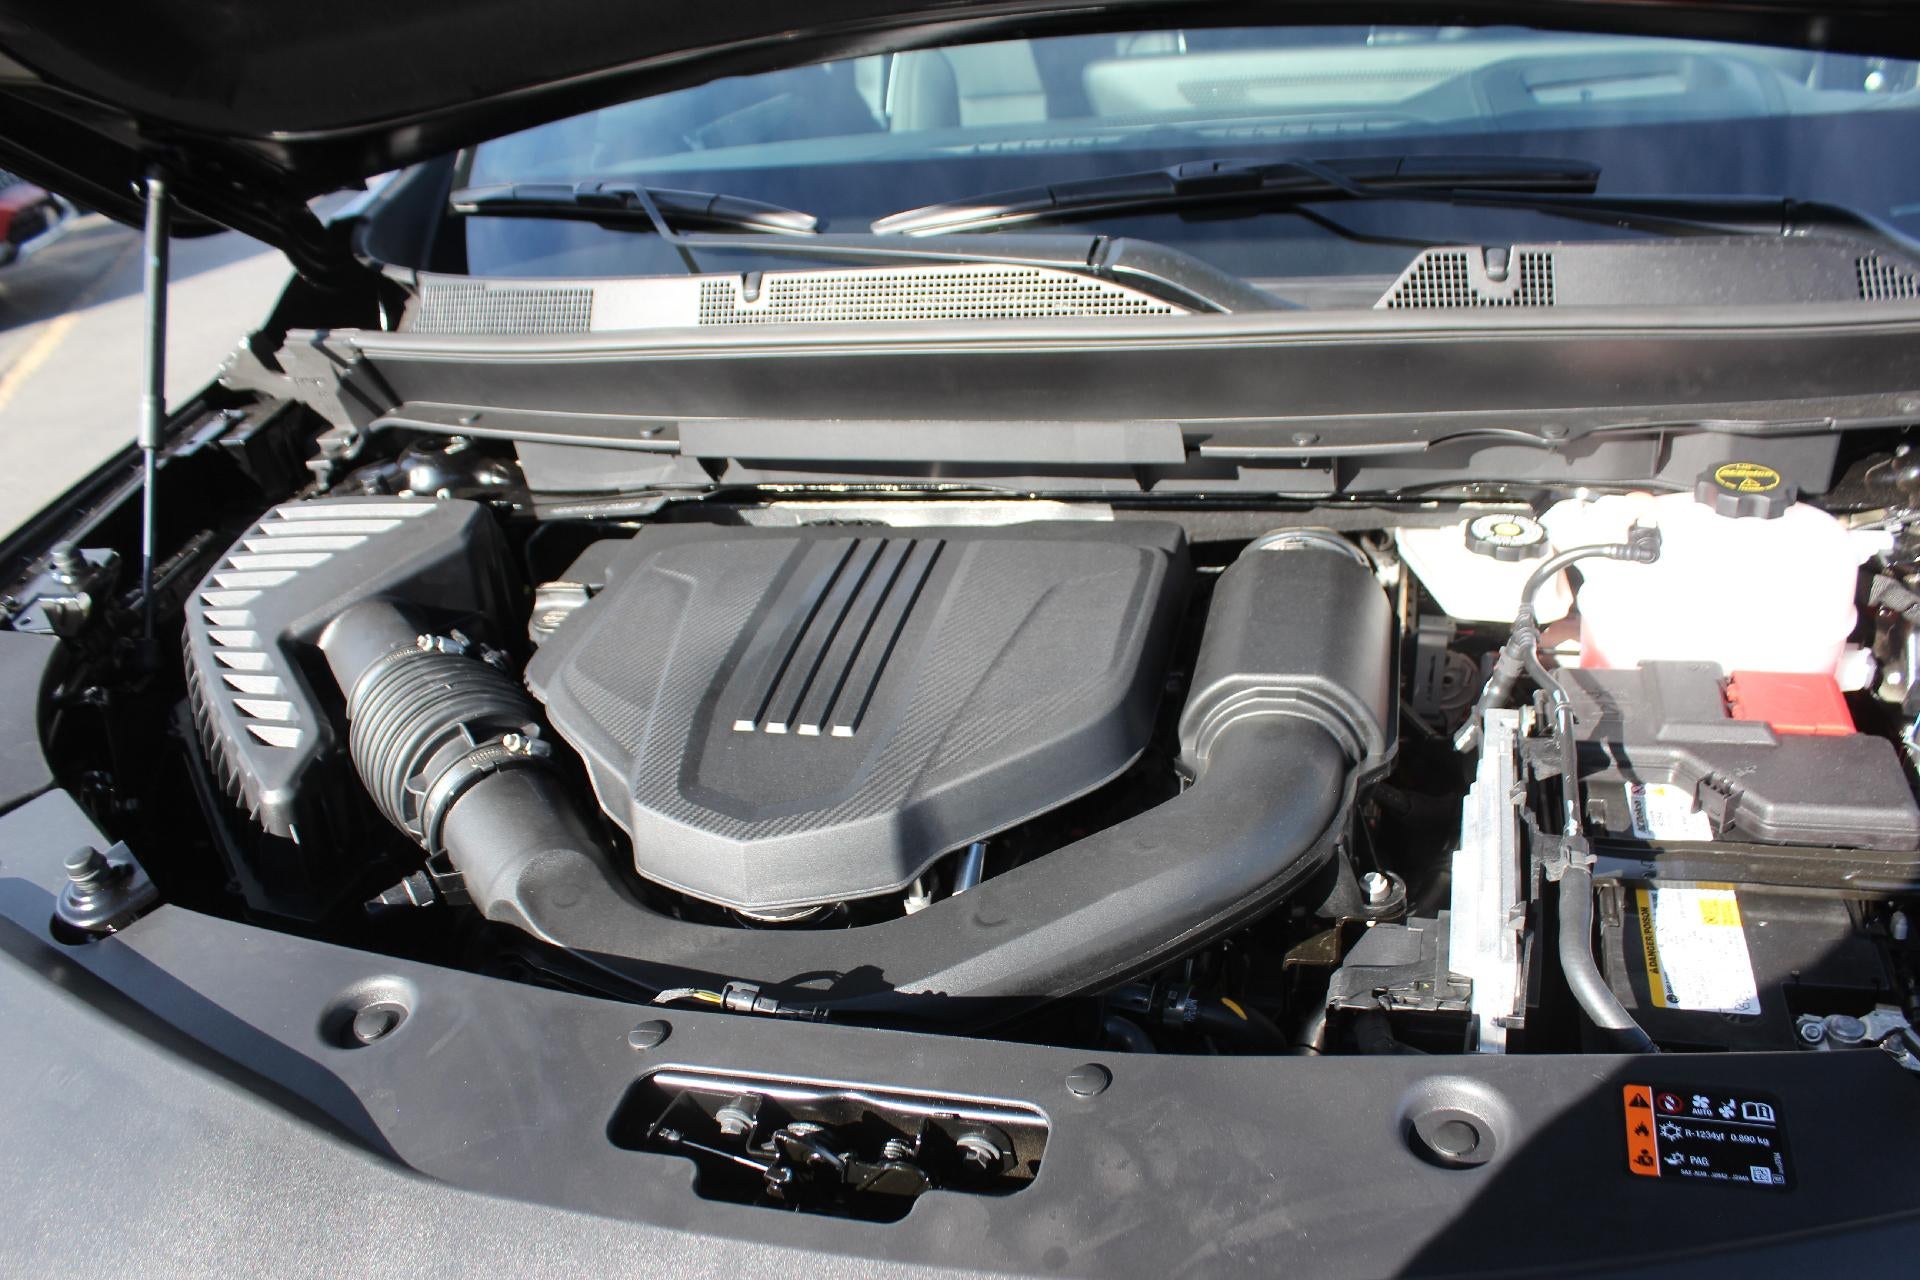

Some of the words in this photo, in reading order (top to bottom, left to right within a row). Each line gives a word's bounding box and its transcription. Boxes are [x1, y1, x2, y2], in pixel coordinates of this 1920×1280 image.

[1692, 1107, 1713, 1117] AUTO
[1684, 1128, 1725, 1141] R-1234yf
[1757, 1135, 1770, 1147] kg
[1689, 1155, 1710, 1167] PAG
